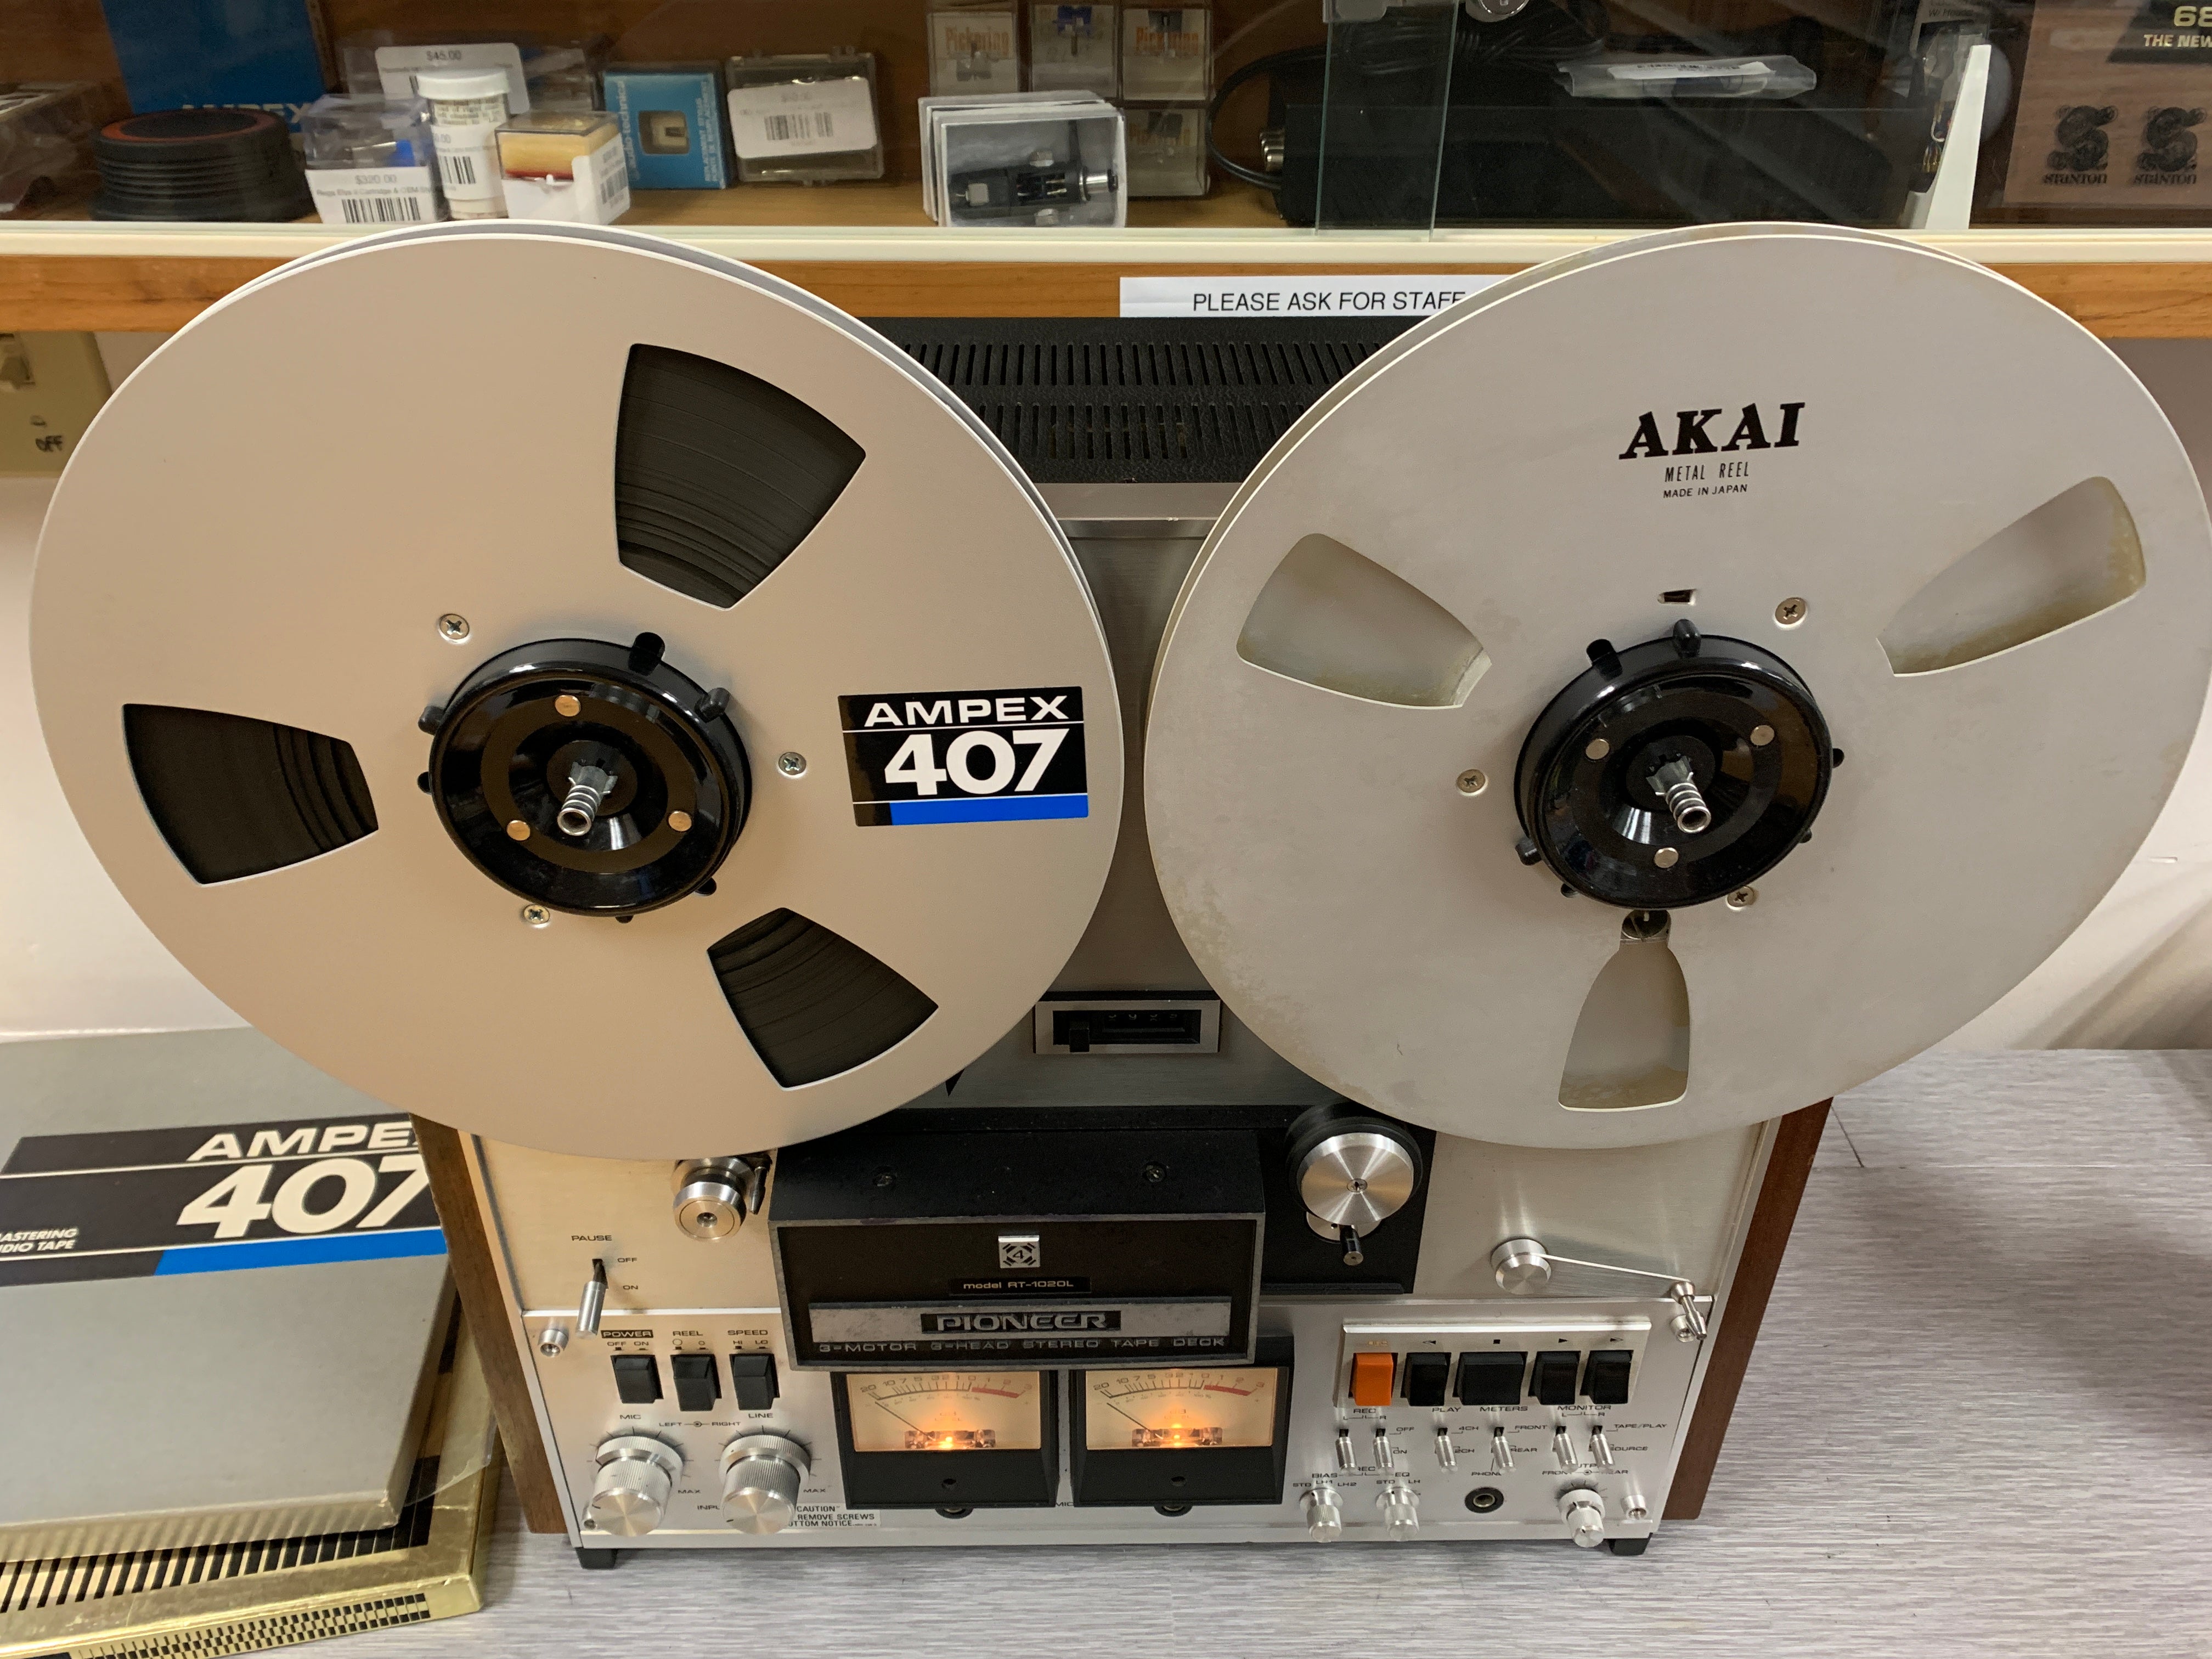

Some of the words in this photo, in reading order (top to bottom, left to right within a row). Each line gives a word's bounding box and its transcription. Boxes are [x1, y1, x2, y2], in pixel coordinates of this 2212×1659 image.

[2143, 34, 2175, 47] THE
[1193, 293, 1280, 311] PLEASE
[1288, 292, 1332, 311] ASK
[1339, 292, 1385, 310] FOR
[1619, 402, 1805, 460] AKAI
[1665, 465, 1705, 482] METAL
[1719, 461, 1750, 478] REEL
[1663, 488, 1692, 498] MADE
[1698, 487, 1708, 495] IN
[1712, 484, 1748, 495] JAPAN
[864, 696, 1069, 727] AMPEX
[884, 729, 1070, 796] 407
[187, 1121, 419, 1161] AMPE
[176, 1154, 430, 1239] 407
[0, 1228, 77, 1243] ASTERING
[37, 1240, 75, 1251] TAPE
[1008, 1280, 1074, 1289] RT-1020L
[937, 1313, 1107, 1331] PIONEER
[819, 1343, 917, 1352] 3-MOTOR
[930, 1341, 1009, 1351] 3-HEAD
[1023, 1339, 1099, 1348] STEREO
[1110, 1339, 1159, 1347] TAPE
[1173, 1338, 1224, 1347] DECK
